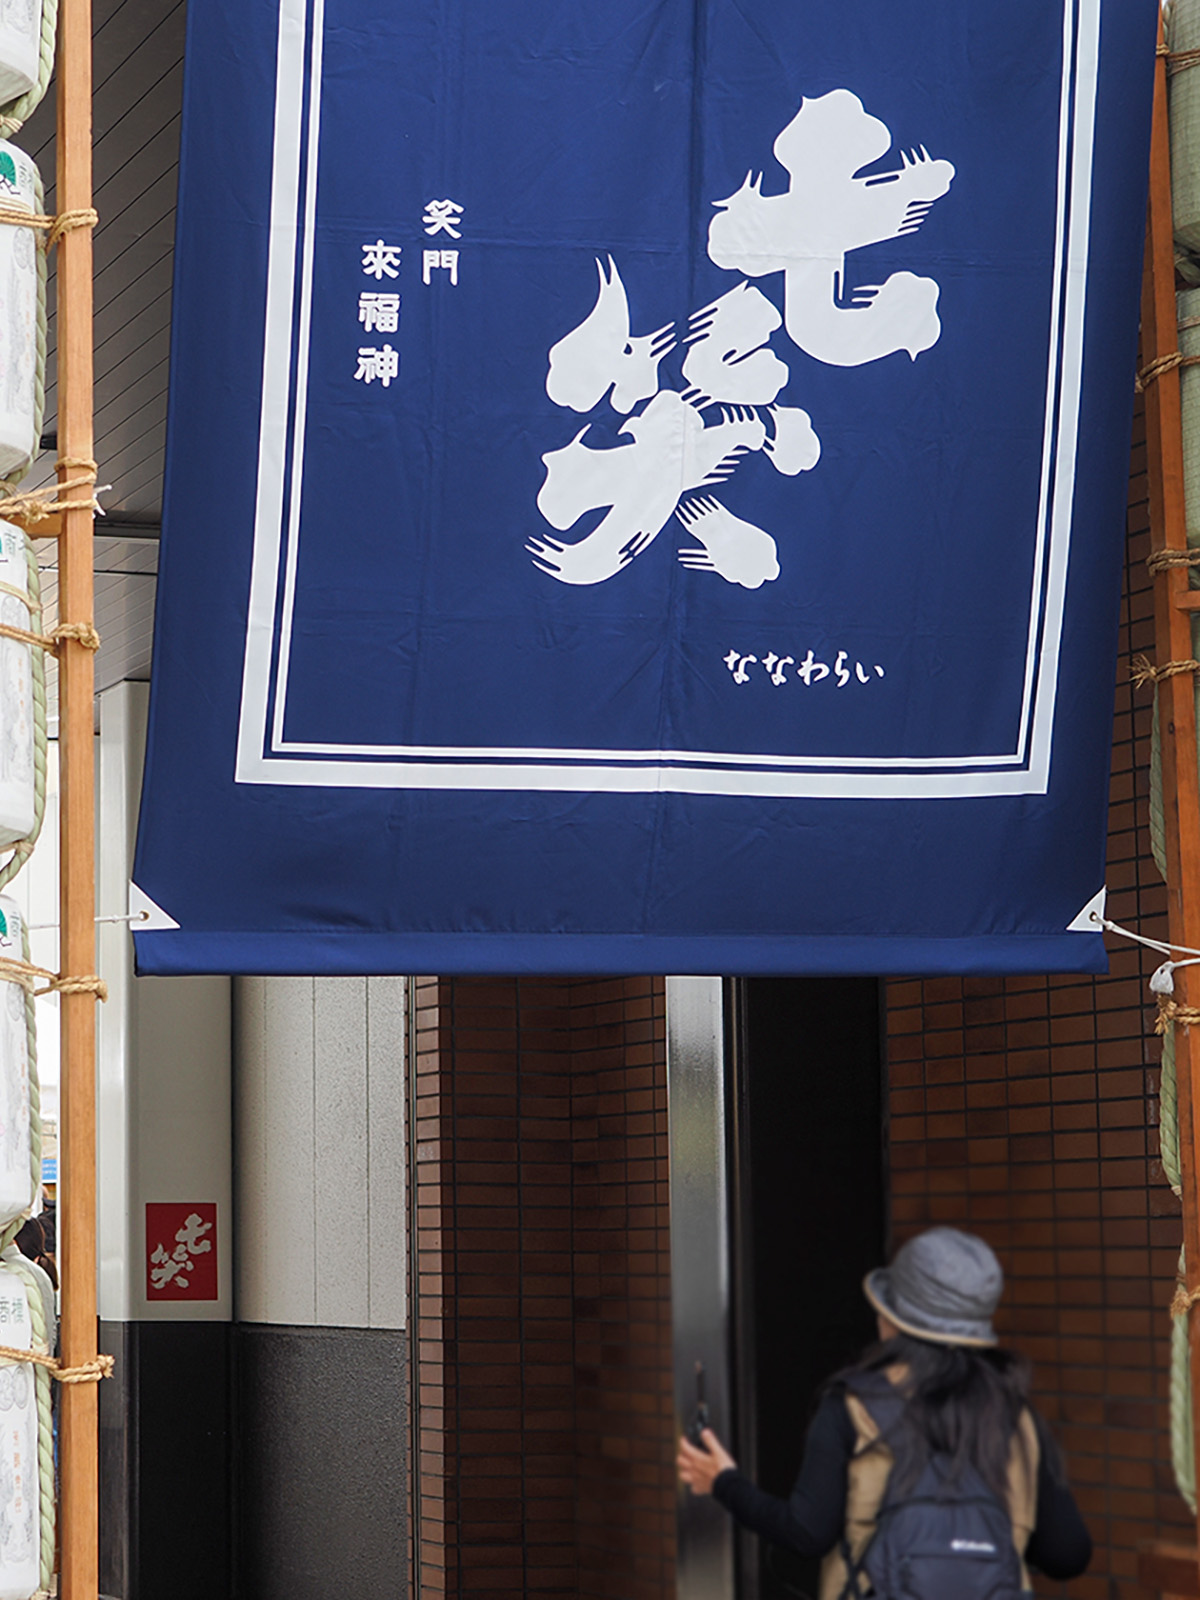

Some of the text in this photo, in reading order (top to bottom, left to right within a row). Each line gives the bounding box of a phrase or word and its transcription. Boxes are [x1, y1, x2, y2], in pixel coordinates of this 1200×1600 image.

[422, 199, 464, 286] 笑門
[723, 649, 885, 688] ななわらい
